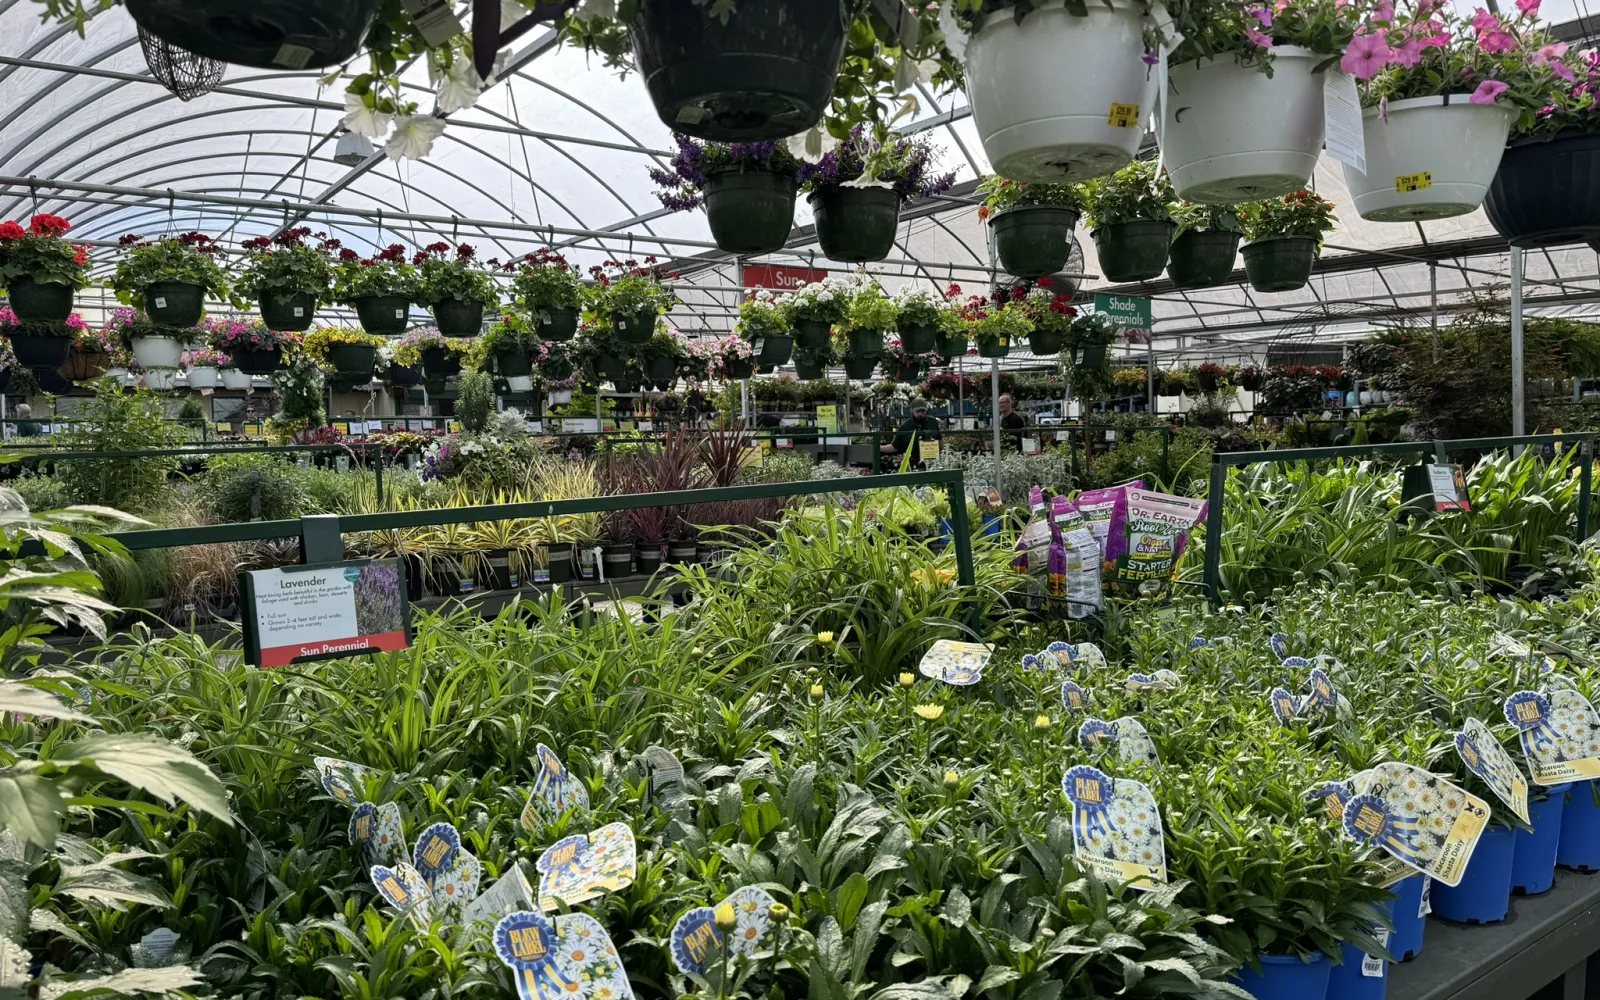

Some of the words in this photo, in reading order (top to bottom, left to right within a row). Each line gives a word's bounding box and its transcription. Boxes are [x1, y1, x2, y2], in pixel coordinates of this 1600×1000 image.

[776, 271, 800, 286] Sun
[1109, 297, 1136, 311] Shade
[1131, 519, 1159, 533] Root
[1127, 558, 1172, 571] STARTER
[280, 576, 327, 589] Lavender
[268, 623, 297, 631] depending
[300, 647, 320, 656] Sun
[322, 638, 369, 655] Perennial
[1515, 700, 1538, 714] BLEW
[1517, 709, 1542, 721] LABEL
[1557, 767, 1576, 775] Daisy
[1076, 778, 1100, 792] BLEW
[1076, 787, 1102, 802] LABEL
[1354, 804, 1373, 831] BLEW
[1363, 811, 1385, 837] LABEL
[1081, 853, 1114, 866] Macaroon
[1434, 843, 1452, 875] Macaroon
[1442, 856, 1455, 879] Shasta
[1451, 839, 1465, 857] Daisy
[1104, 865, 1123, 877] Daisy
[508, 926, 540, 944] BLEW
[684, 921, 713, 951] BLEW
[512, 940, 546, 957] LABEL
[690, 934, 723, 964] LAL
